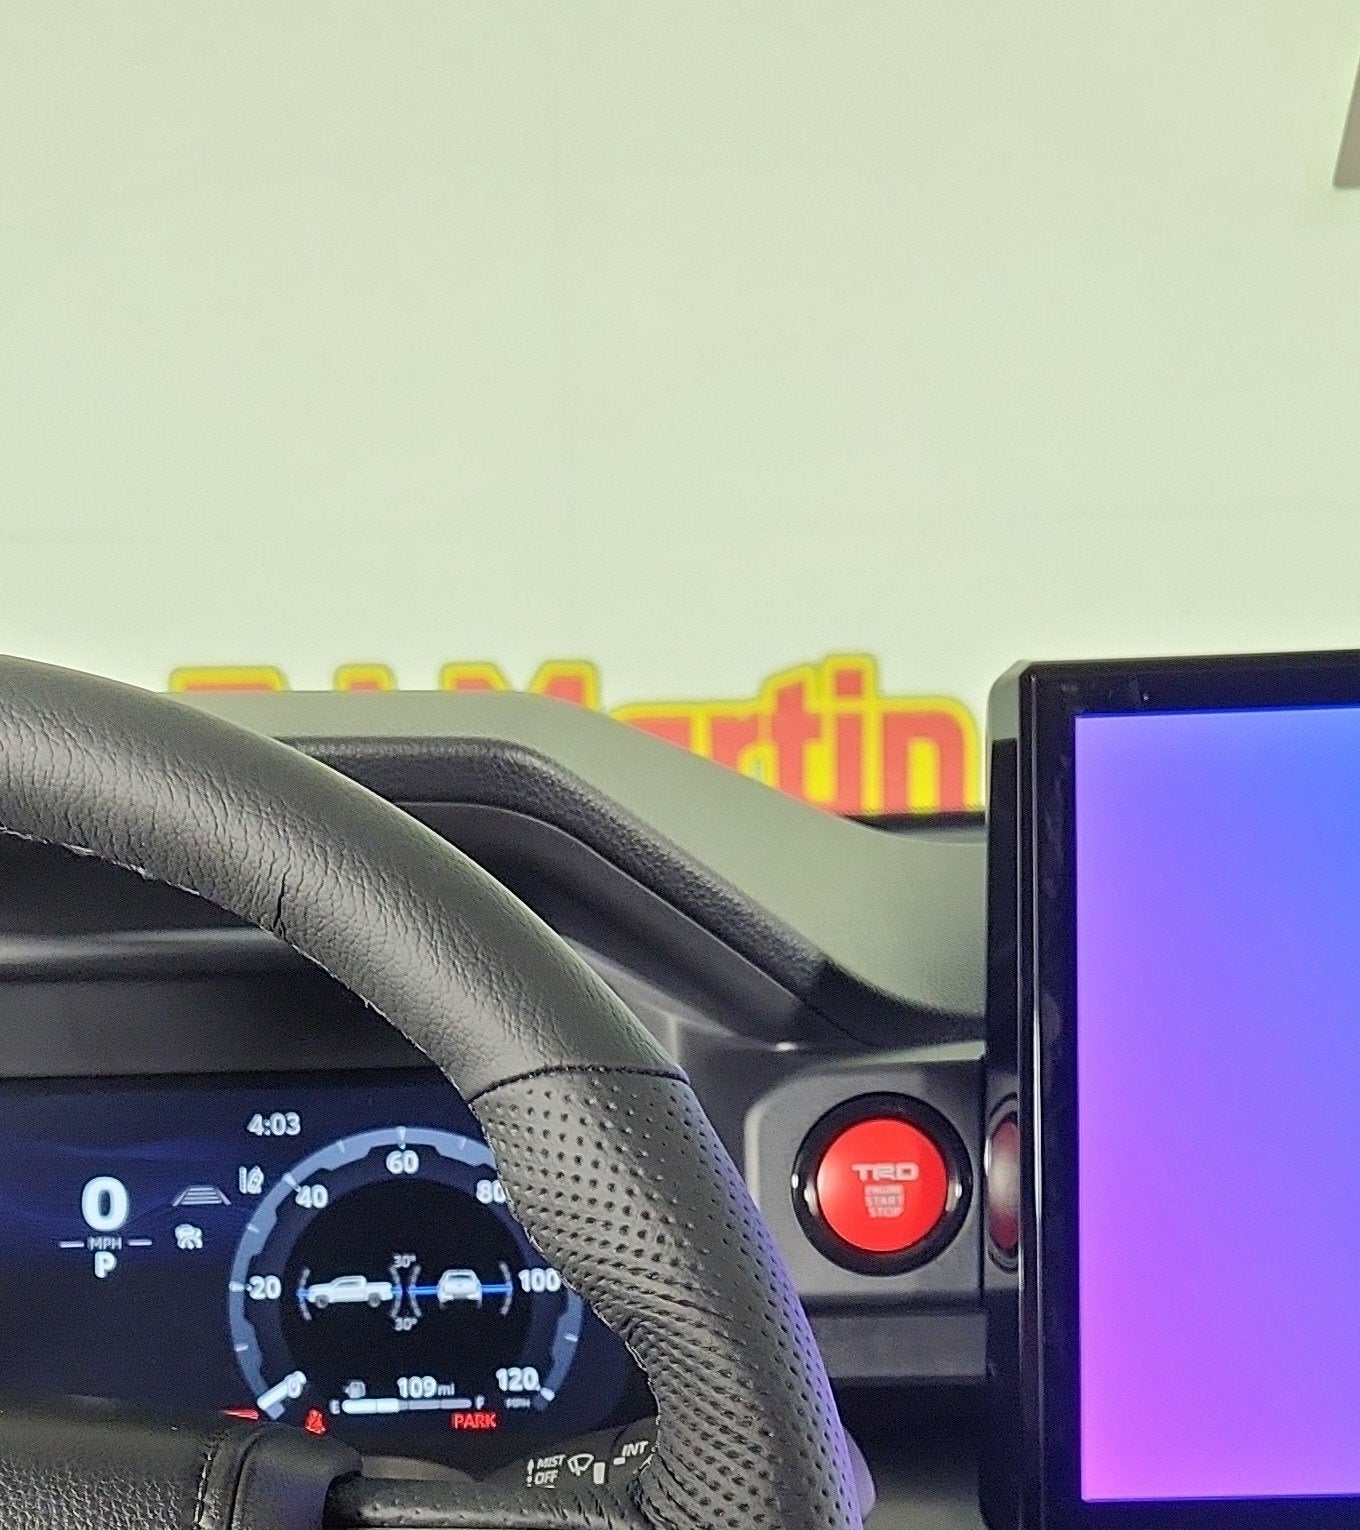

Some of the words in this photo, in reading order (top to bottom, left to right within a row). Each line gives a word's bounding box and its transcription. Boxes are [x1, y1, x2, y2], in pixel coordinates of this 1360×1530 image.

[247, 1112, 301, 1137] 4:03
[386, 1151, 419, 1175] 60
[851, 1162, 920, 1182] TRD
[82, 1176, 129, 1231] 0
[296, 1184, 328, 1208] 40
[476, 1180, 507, 1204] 80
[87, 1236, 123, 1251] MPH
[94, 1252, 118, 1279] P
[248, 1276, 282, 1300] 20
[518, 1269, 562, 1293] 100
[397, 1376, 437, 1399] 109
[437, 1382, 455, 1397] mi
[496, 1367, 539, 1392] 120
[453, 1413, 498, 1430] PARK
[621, 1441, 649, 1457] INT
[537, 1454, 566, 1469] MIST
[534, 1469, 560, 1486] OFF
